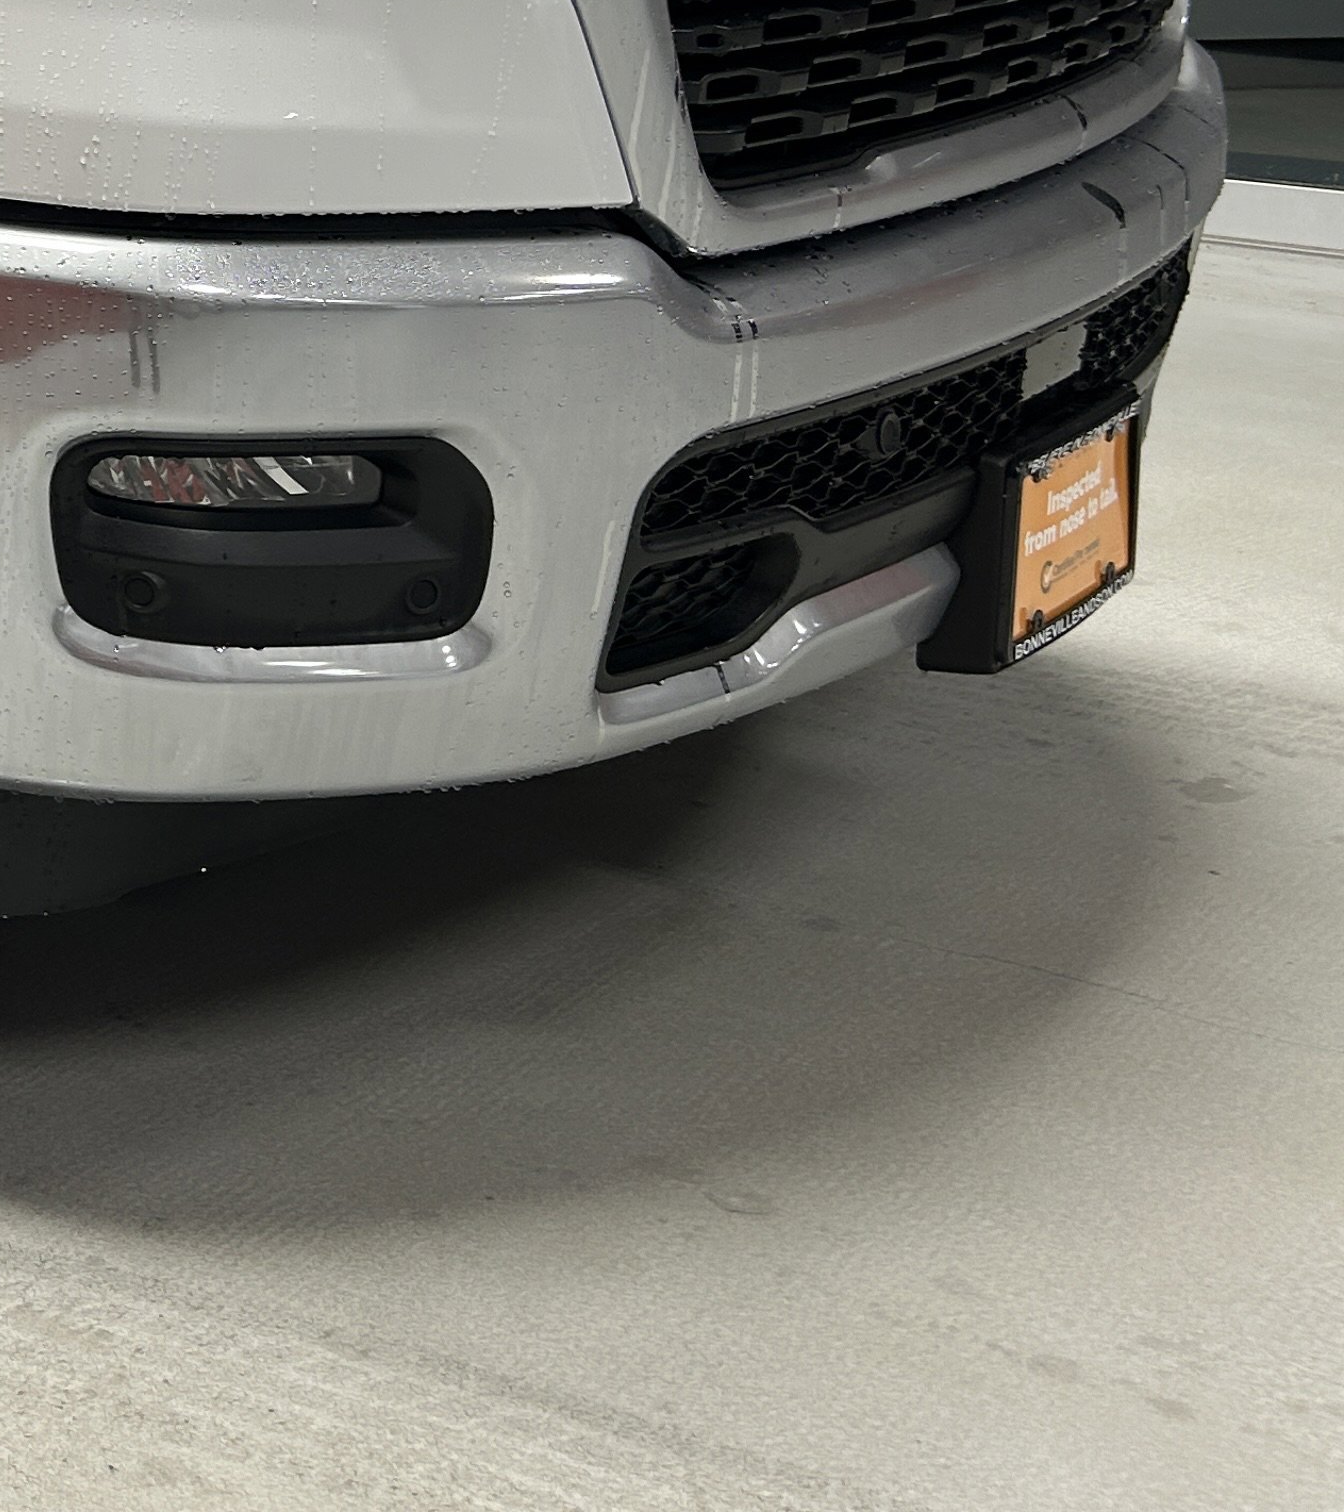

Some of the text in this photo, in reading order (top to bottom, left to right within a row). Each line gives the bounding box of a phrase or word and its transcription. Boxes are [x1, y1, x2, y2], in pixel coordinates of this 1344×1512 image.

[1046, 459, 1102, 515] Inspected
[1024, 524, 1057, 557] from
[1060, 506, 1086, 538] nose
[1088, 496, 1099, 519] to
